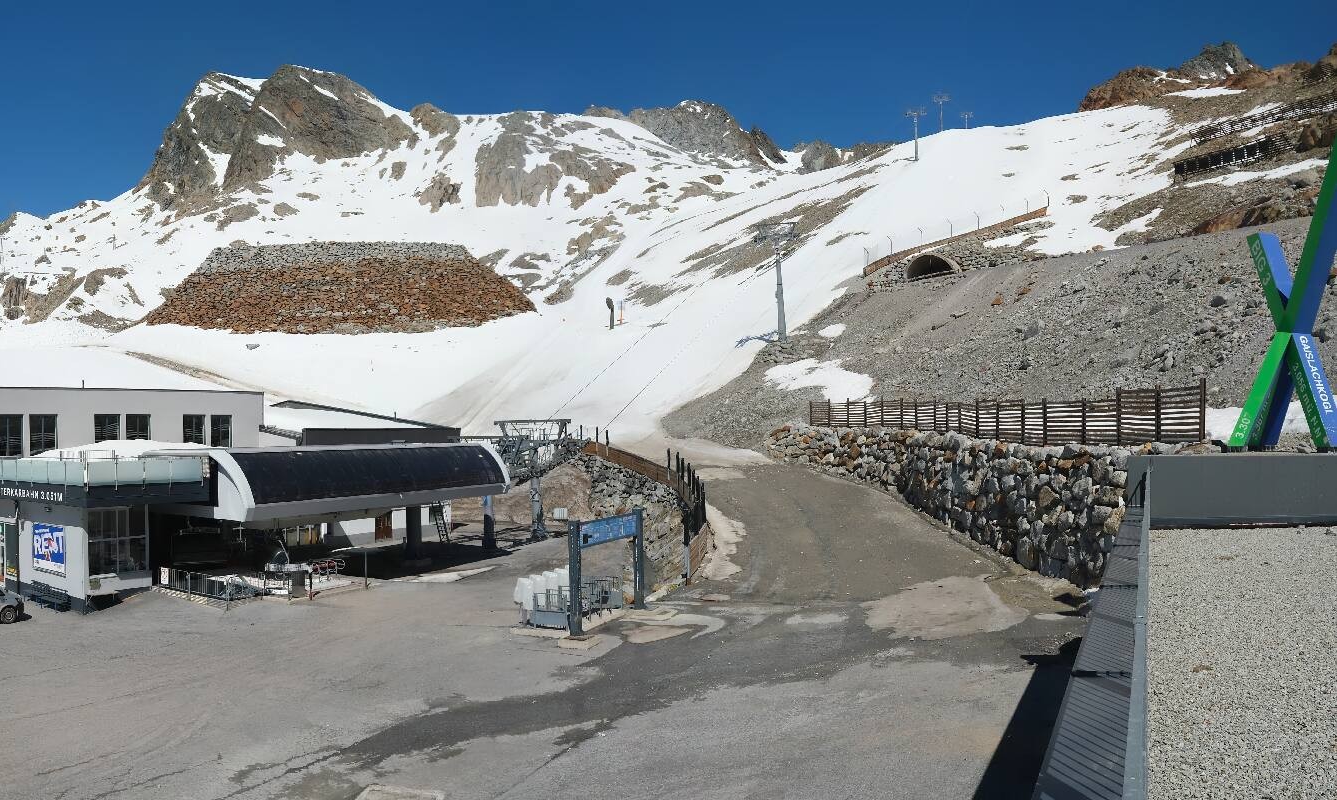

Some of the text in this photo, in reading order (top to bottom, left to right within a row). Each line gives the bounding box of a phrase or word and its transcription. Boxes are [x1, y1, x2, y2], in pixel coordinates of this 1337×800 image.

[1252, 240, 1271, 286] BIG 3
[1299, 335, 1334, 414] GAISLACHKOGL
